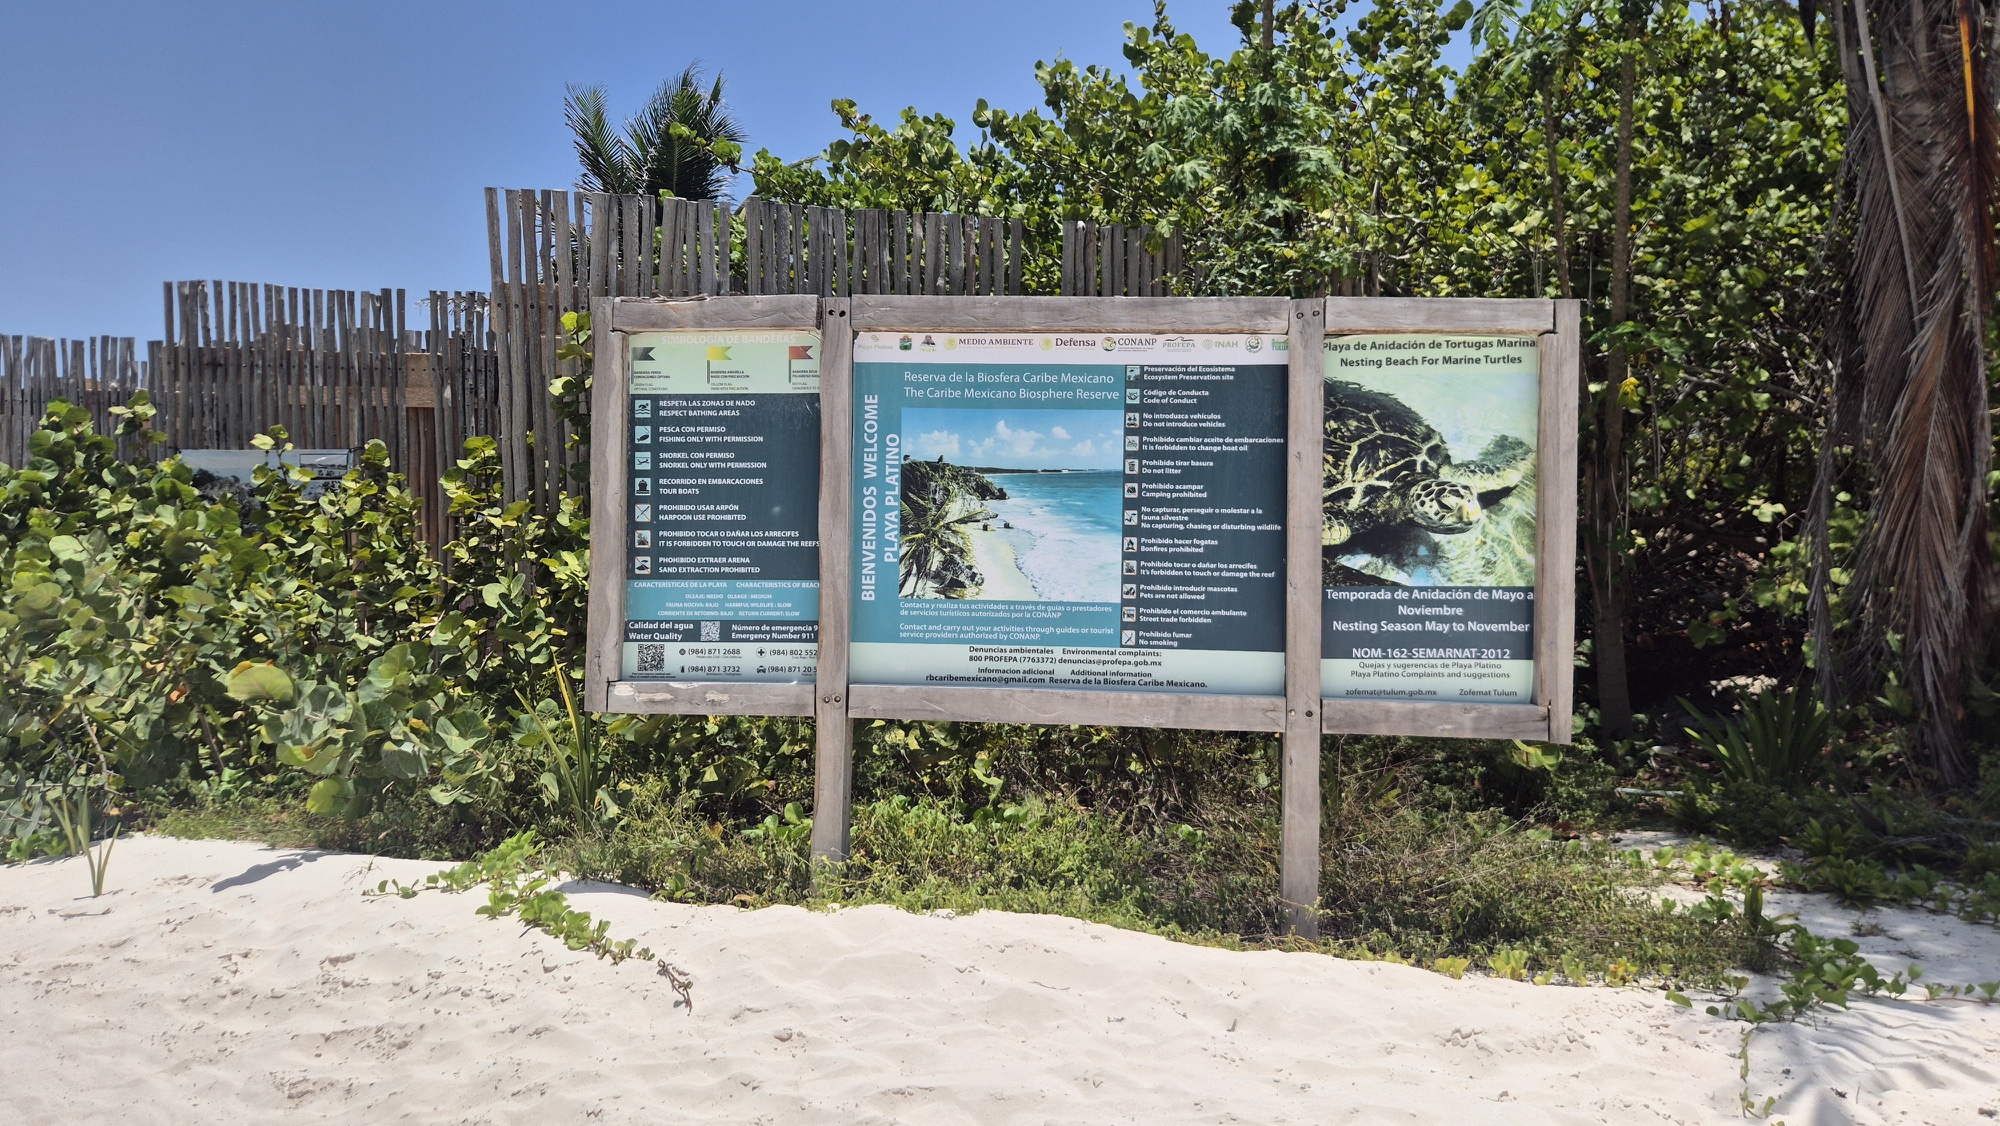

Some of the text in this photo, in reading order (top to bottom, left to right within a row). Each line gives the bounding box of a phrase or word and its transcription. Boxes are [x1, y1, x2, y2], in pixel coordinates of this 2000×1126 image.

[662, 333, 796, 344] SIMBOLOGÍA DE BANDERAS
[1055, 338, 1096, 347] Defensa
[1118, 338, 1157, 346] CONANP
[1323, 341, 1350, 353] Playa
[1353, 341, 1367, 350] de
[1370, 340, 1425, 350] Anidación
[1428, 339, 1442, 349] de
[1444, 339, 1494, 351] Tortugas
[1340, 354, 1523, 369] Nesting Beach For Marine Turtles
[905, 371, 1114, 383] Reserva de la Biosfera Caribe Mexicano
[904, 386, 1119, 401] The Caribe Mexicano Biosphere Reserve
[1143, 388, 1167, 397] Código
[862, 394, 878, 601] BIENVENIDOS WELCOME
[884, 433, 900, 563] PLAYA PLATINO
[1142, 490, 1207, 499] Camping prohibited
[1326, 588, 1392, 602] Temporada
[1394, 588, 1410, 599] de
[1412, 588, 1472, 599] Anidación
[1474, 588, 1489, 599] de
[1492, 589, 1524, 602] Mayo
[1398, 604, 1463, 615] Noviembre
[1333, 620, 1529, 633] Nesting Season May to November
[629, 631, 682, 642] Water Quality
[732, 632, 770, 640] Emergency
[1150, 638, 1177, 647] smoking
[688, 648, 706, 656] (984)
[1009, 646, 1054, 654] ambientales
[1063, 647, 1161, 658] Environmental complaints:
[1353, 648, 1510, 658] NOM-162-SEMARNAT-2012
[1019, 656, 1057, 665] (7763372)
[1058, 658, 1162, 667] denuncias@profepa.gob.mx
[1359, 661, 1385, 670] Quejas
[1393, 661, 1438, 670] sugerencias
[1452, 661, 1472, 670] Playa
[688, 665, 706, 673] (984)
[1109, 670, 1152, 678] information
[926, 673, 1045, 685] rbcaribemexicano@gmail.com
[1351, 670, 1371, 679] Playa
[1401, 670, 1445, 679] Complaints
[1463, 671, 1510, 679] suggestions
[1345, 687, 1437, 697] zofemat@tulum.gob.mx
